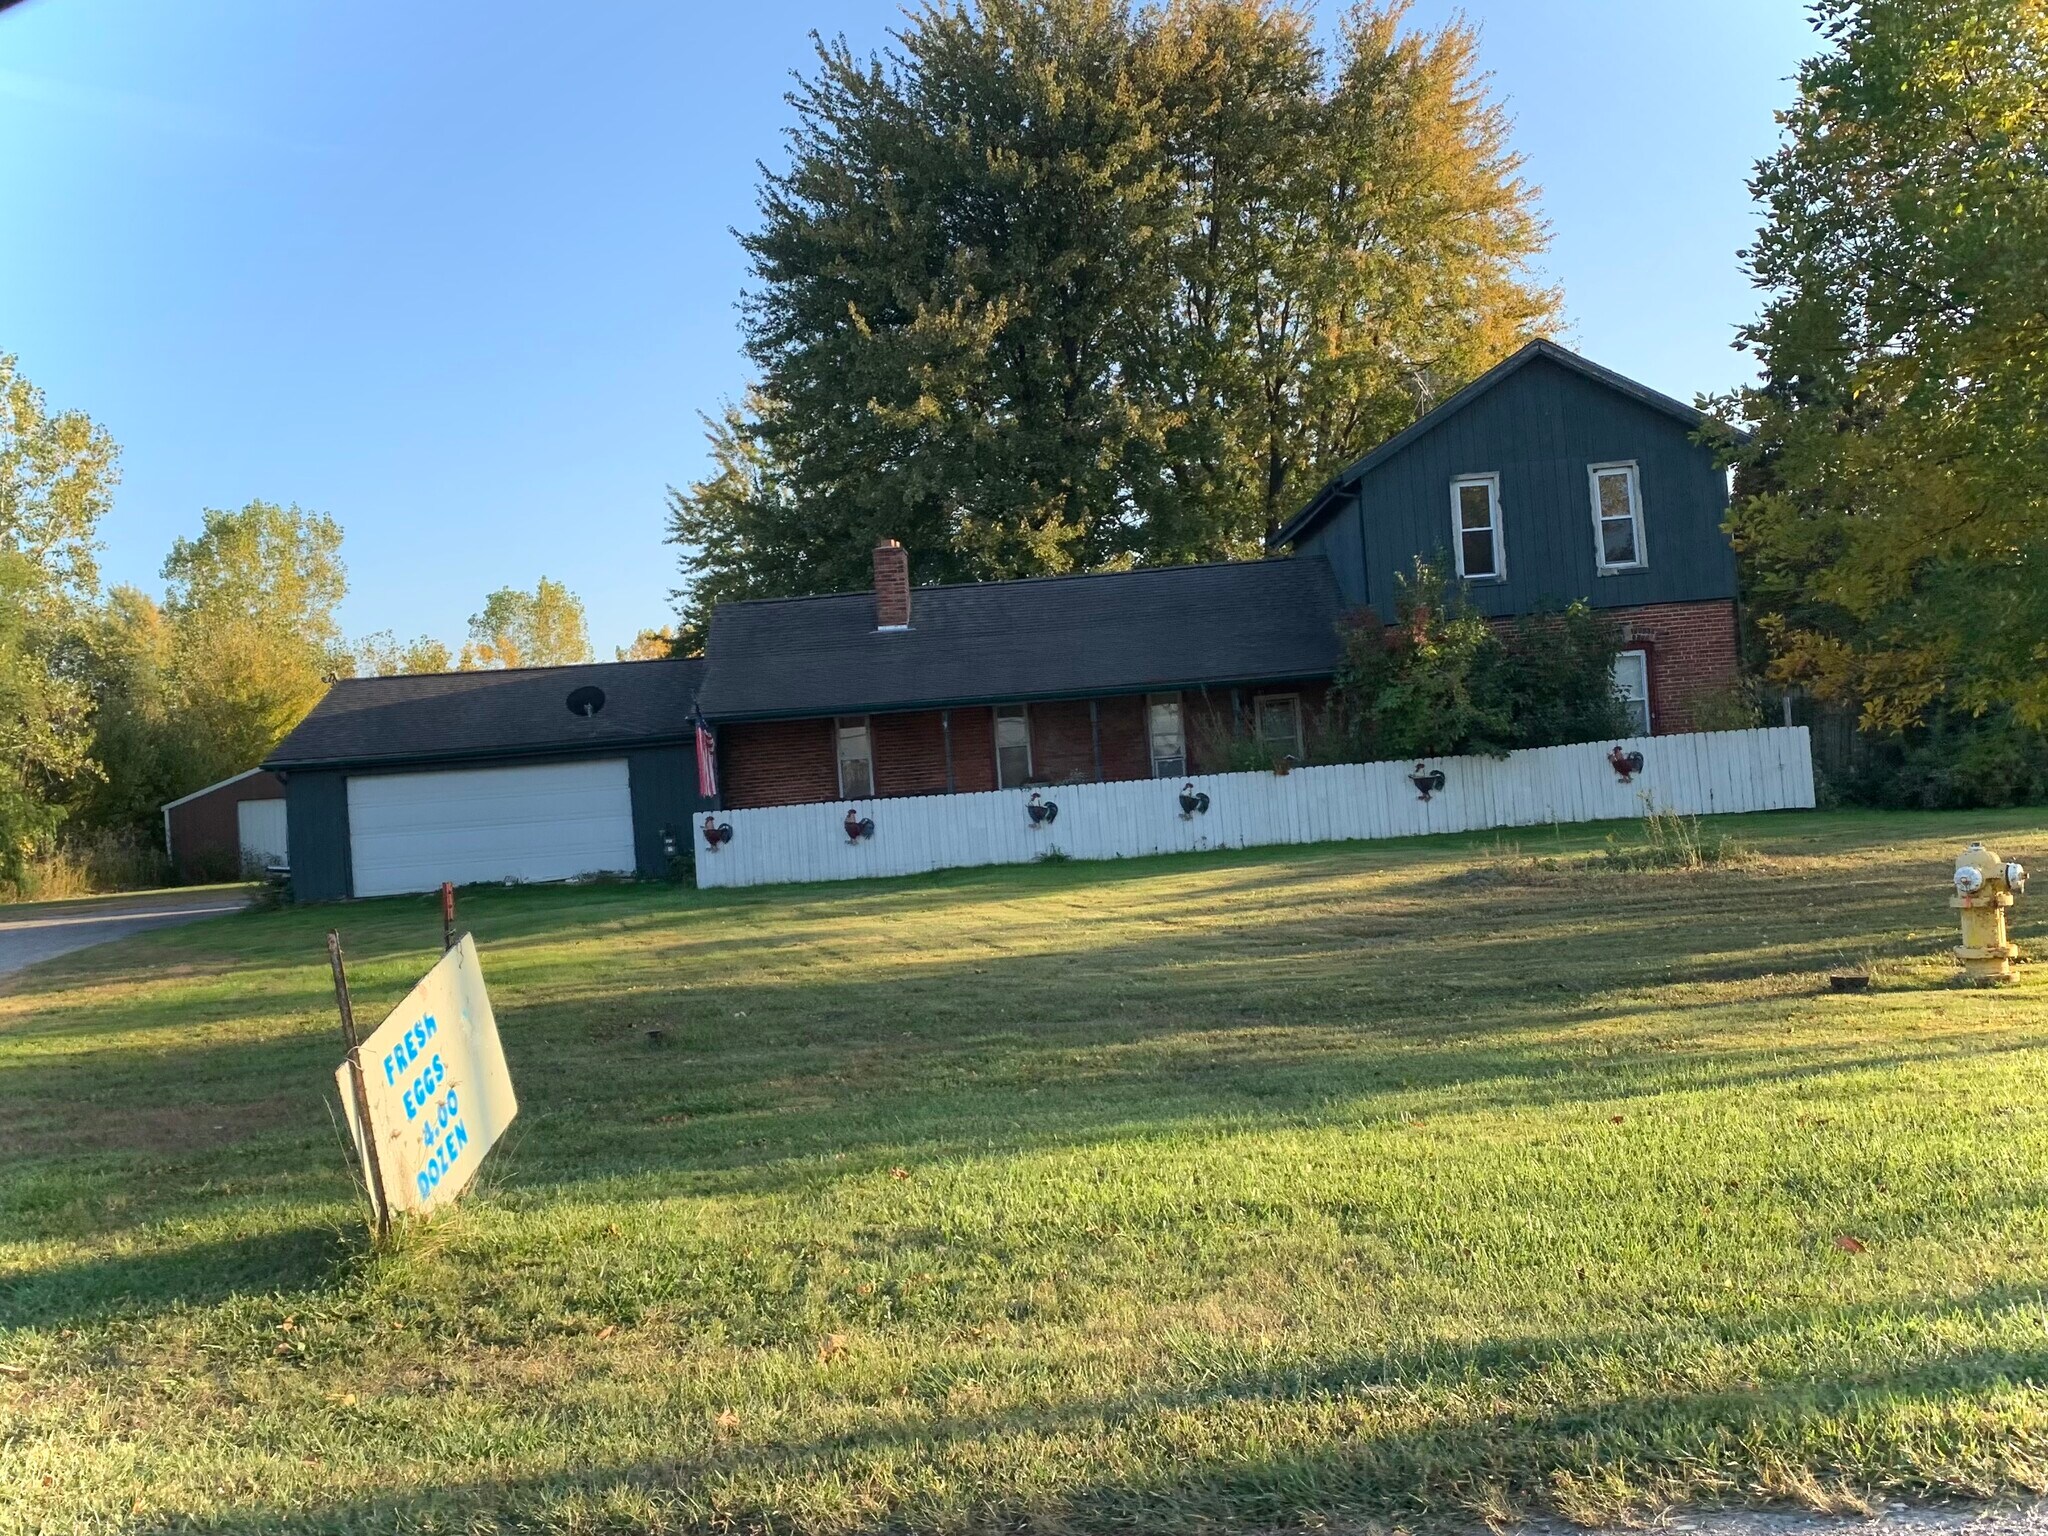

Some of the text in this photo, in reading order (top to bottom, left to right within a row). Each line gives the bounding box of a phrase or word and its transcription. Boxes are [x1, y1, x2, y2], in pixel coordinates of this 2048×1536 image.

[402, 1054, 444, 1120] EGGS
[424, 1089, 458, 1147] 4.00
[417, 1120, 468, 1199] DOZEN
